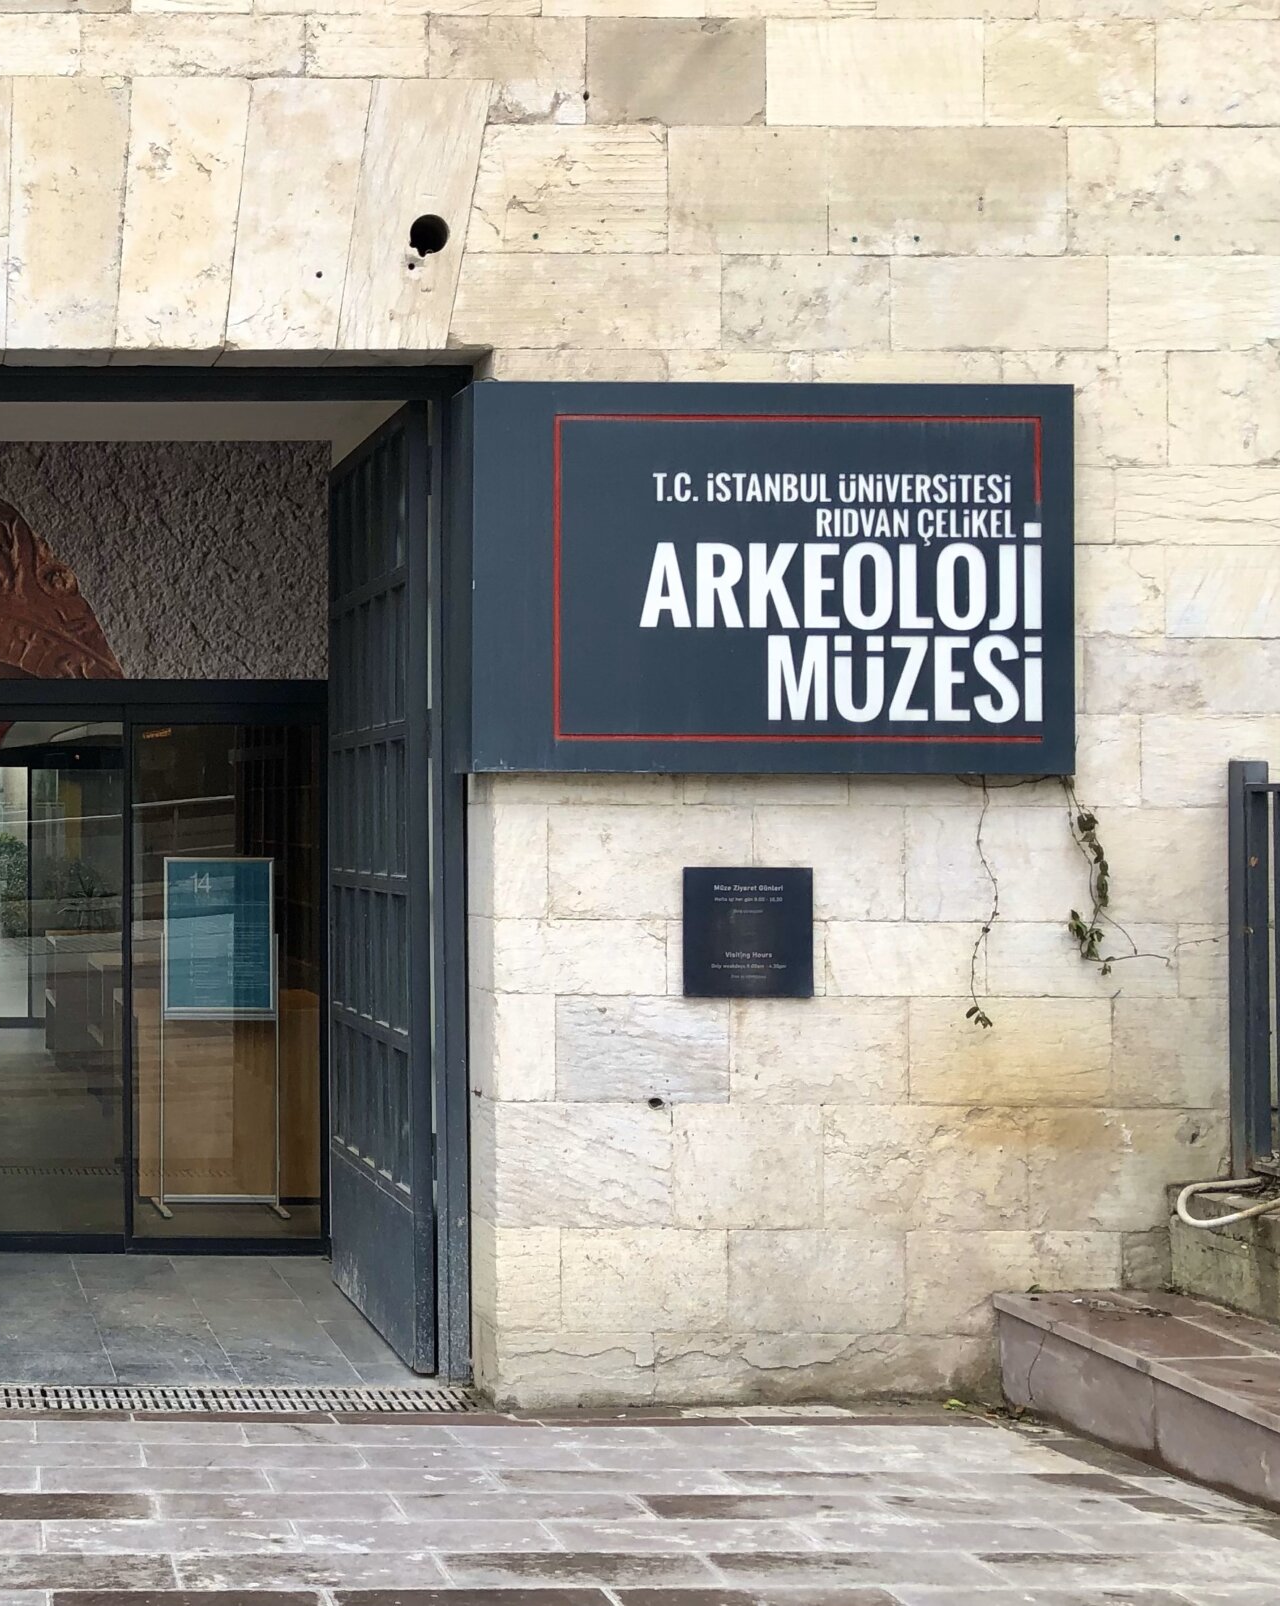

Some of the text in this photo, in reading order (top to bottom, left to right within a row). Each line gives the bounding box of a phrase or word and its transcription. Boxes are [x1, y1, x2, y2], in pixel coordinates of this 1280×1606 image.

[652, 471, 699, 503] T.C.
[816, 508, 909, 538] RIDVAN
[190, 872, 212, 894] 14
[725, 951, 773, 960] Visiting Hours
